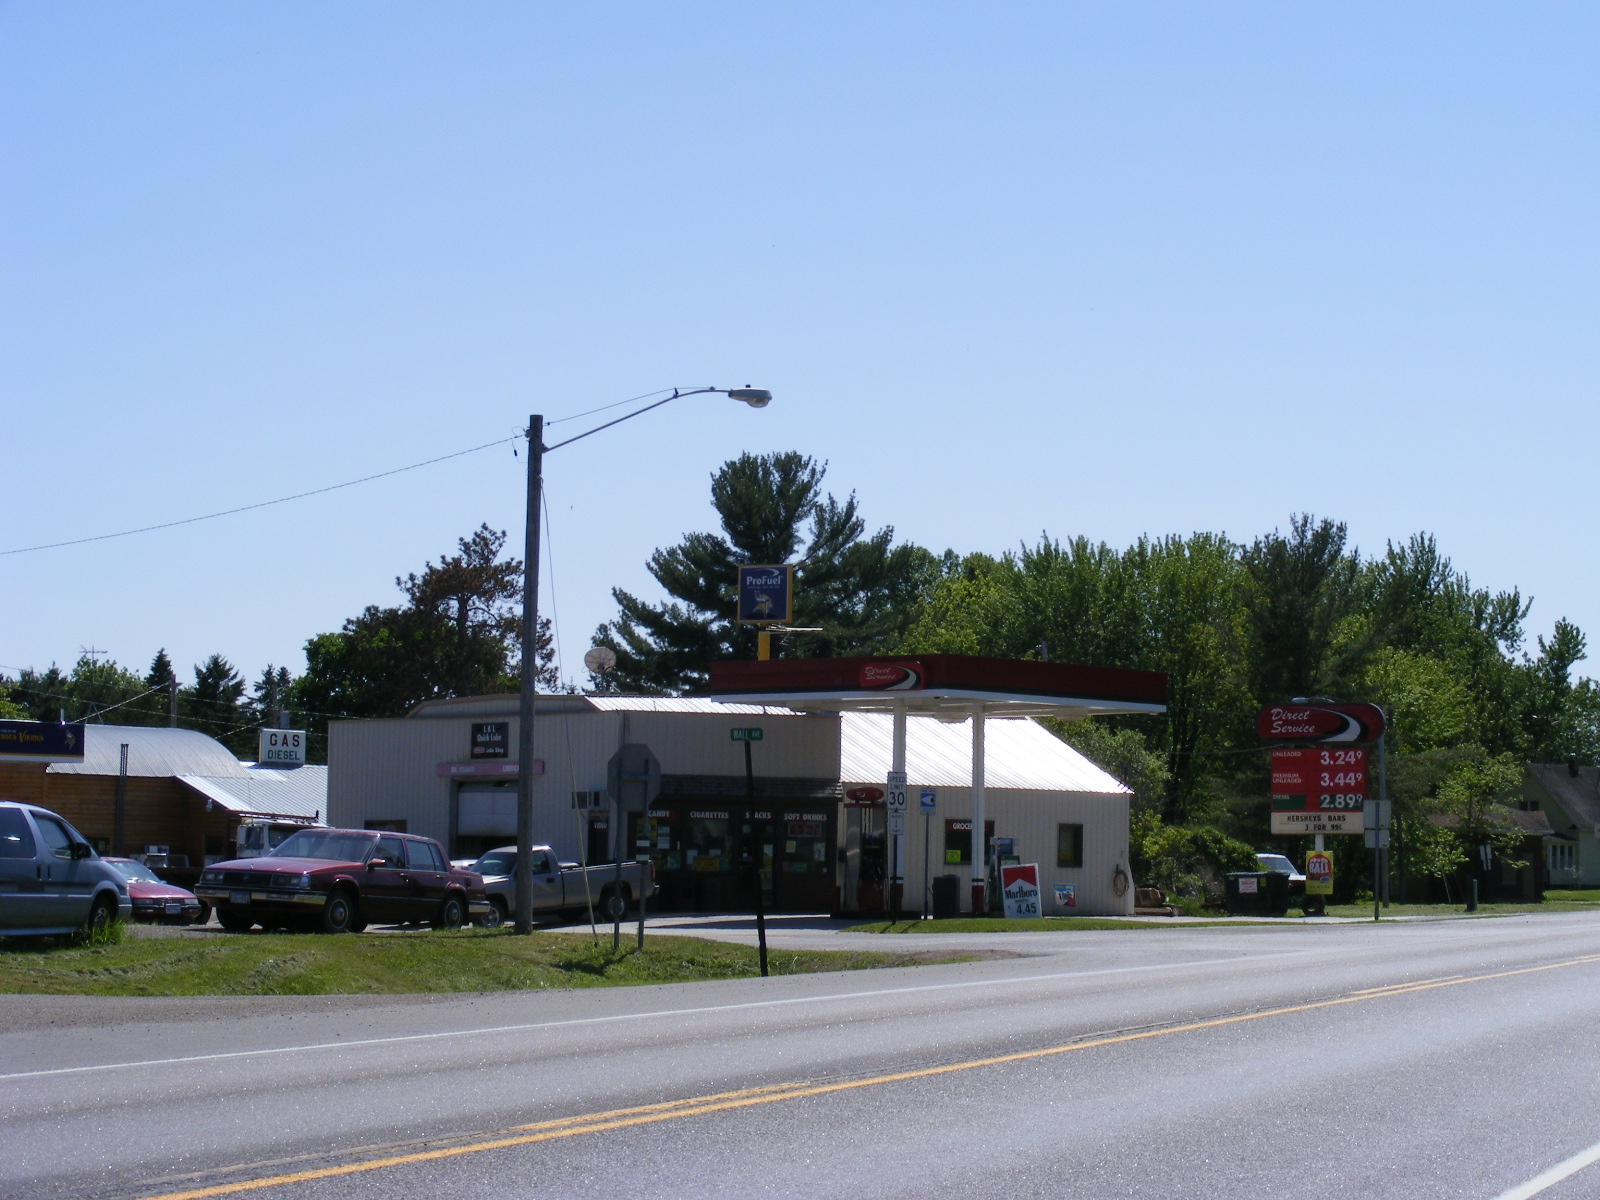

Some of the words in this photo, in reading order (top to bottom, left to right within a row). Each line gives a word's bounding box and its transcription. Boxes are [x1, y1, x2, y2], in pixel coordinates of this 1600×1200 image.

[746, 575, 781, 586] ProFuel
[865, 666, 891, 675] Direct
[1271, 708, 1310, 720] Direct
[1271, 721, 1315, 733] Service
[270, 733, 300, 748] GAS
[477, 733, 490, 742] Quick
[267, 750, 300, 760] DIESEL
[890, 775, 905, 783] SPEED
[888, 791, 905, 806] 30
[648, 810, 671, 818] CANDY
[690, 811, 729, 819] CIGARETTES
[745, 811, 772, 819] SACKS
[802, 813, 828, 821] DRINKS
[952, 822, 972, 830] GROCE
[1313, 824, 1327, 832] FOR
[1308, 862, 1331, 874] BALL
[1004, 885, 1038, 900] Marlboro
[1016, 902, 1037, 915] 4.45
